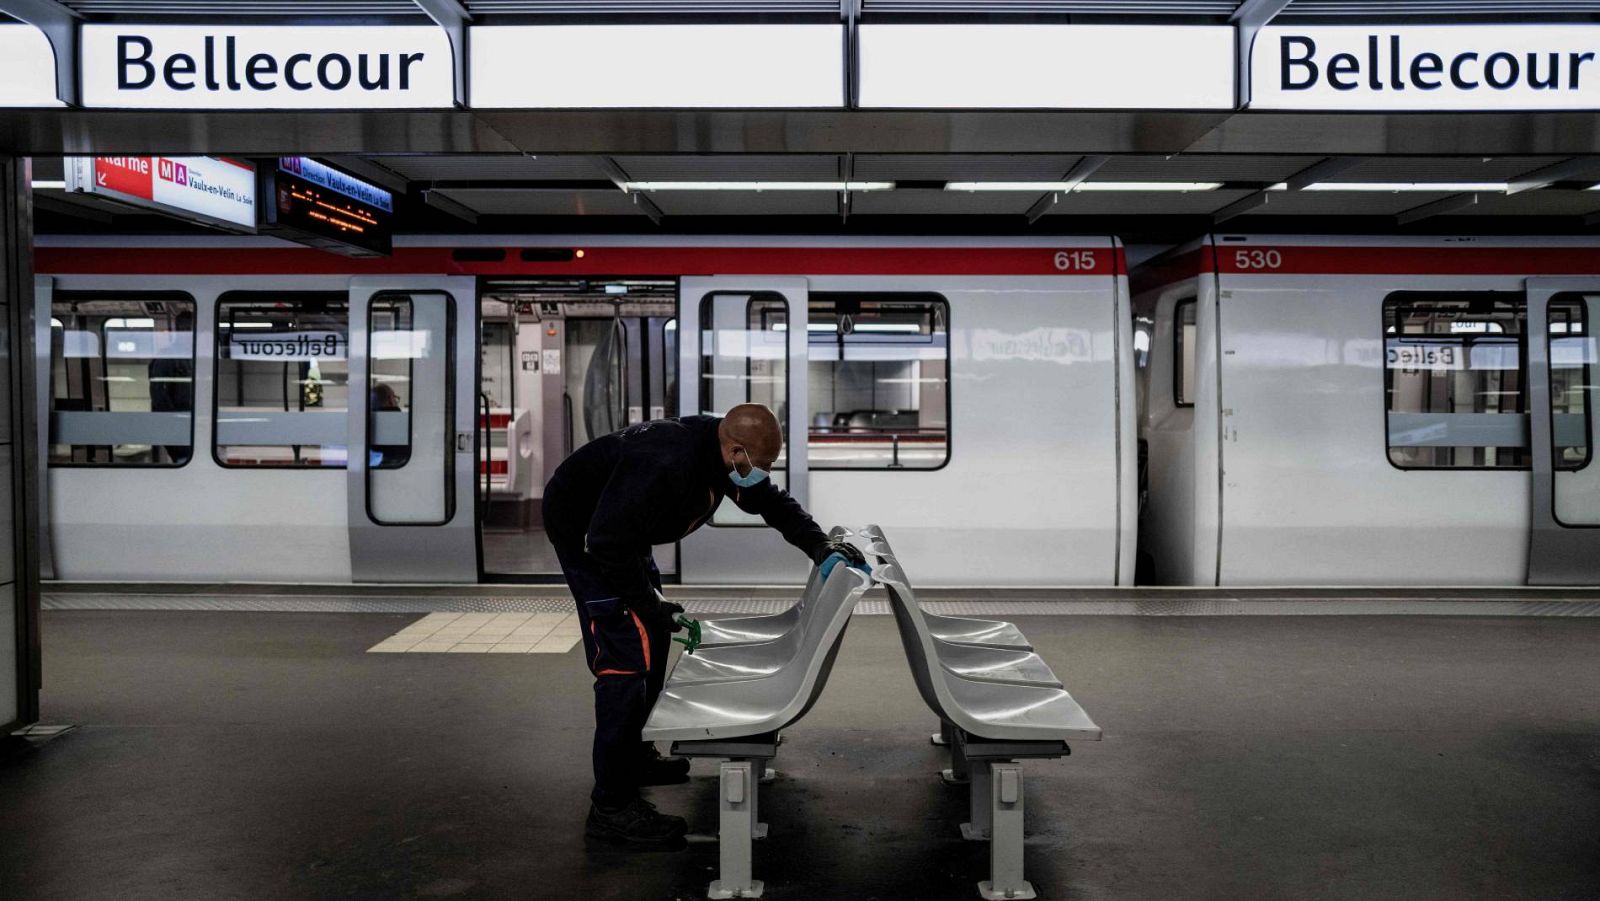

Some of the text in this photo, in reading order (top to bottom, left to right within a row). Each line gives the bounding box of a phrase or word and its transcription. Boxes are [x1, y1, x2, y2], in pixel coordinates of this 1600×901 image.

[117, 36, 424, 90] Bellecour
[1280, 35, 1595, 90] Bellecour
[161, 161, 171, 179] M
[177, 166, 185, 183] A
[189, 176, 235, 200] Vaulx-en-Velin
[326, 172, 373, 200] Vaulx-en-Velin
[1054, 251, 1096, 270] 615
[1235, 250, 1281, 269] 530
